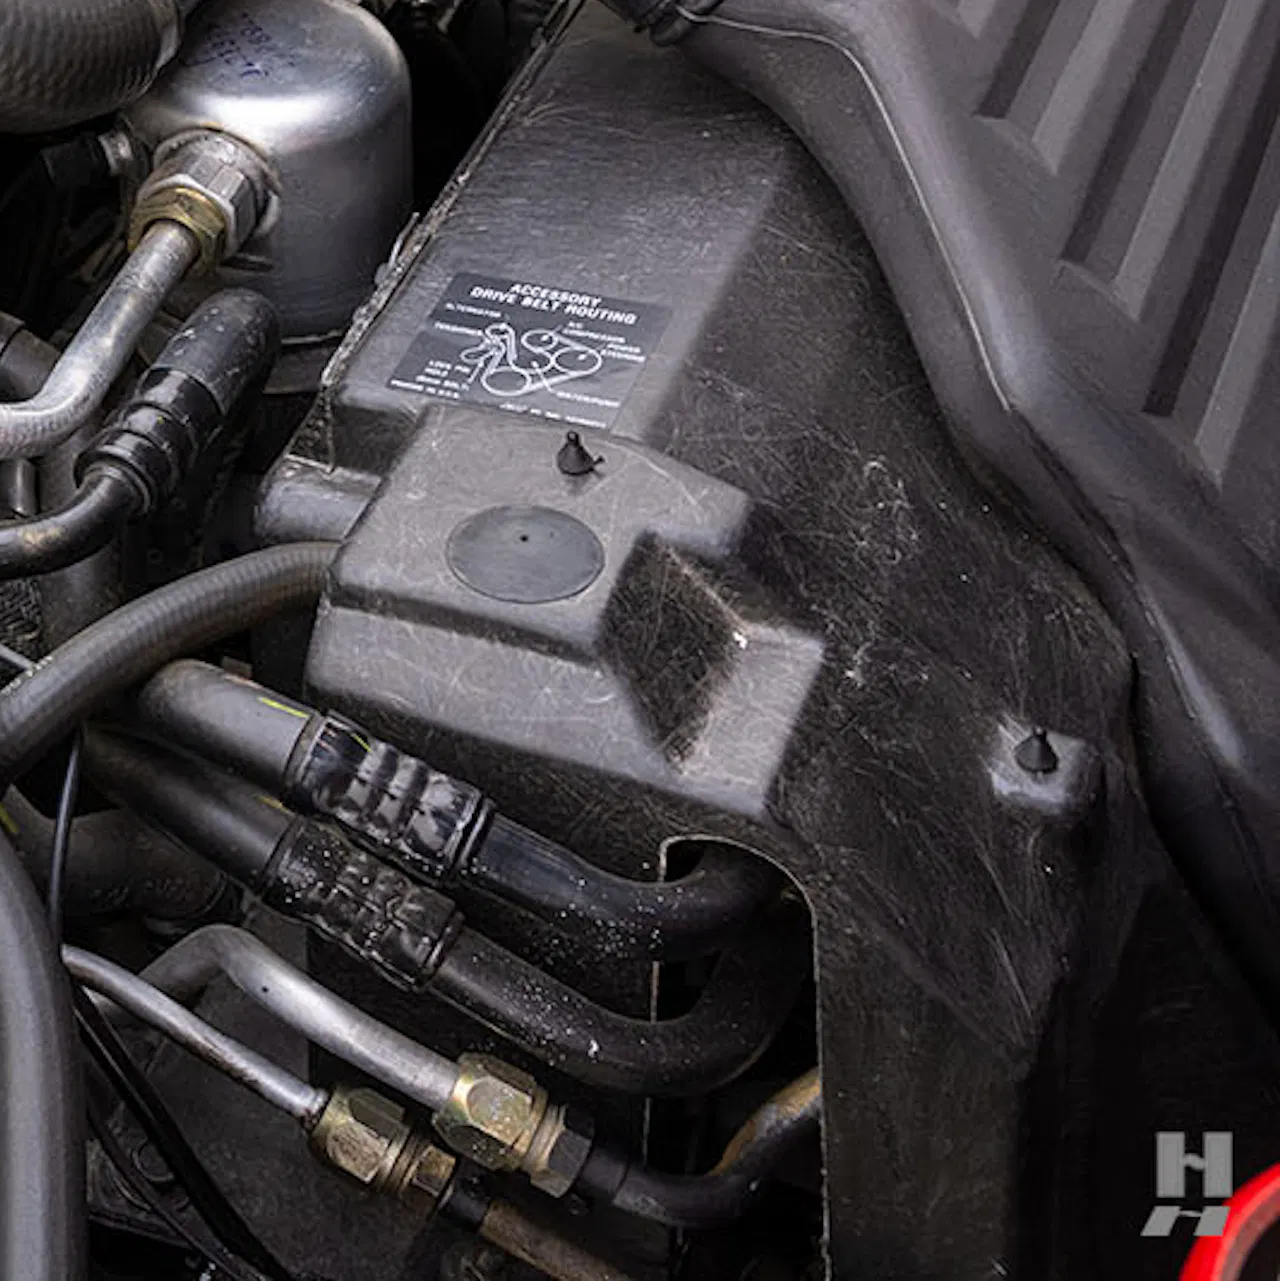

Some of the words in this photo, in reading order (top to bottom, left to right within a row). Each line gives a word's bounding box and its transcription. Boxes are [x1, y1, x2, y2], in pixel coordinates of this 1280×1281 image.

[469, 285, 518, 305] DRIVE
[521, 295, 561, 312] BELT
[563, 303, 638, 326] ROUTING
[509, 283, 602, 308] ACCESSORY
